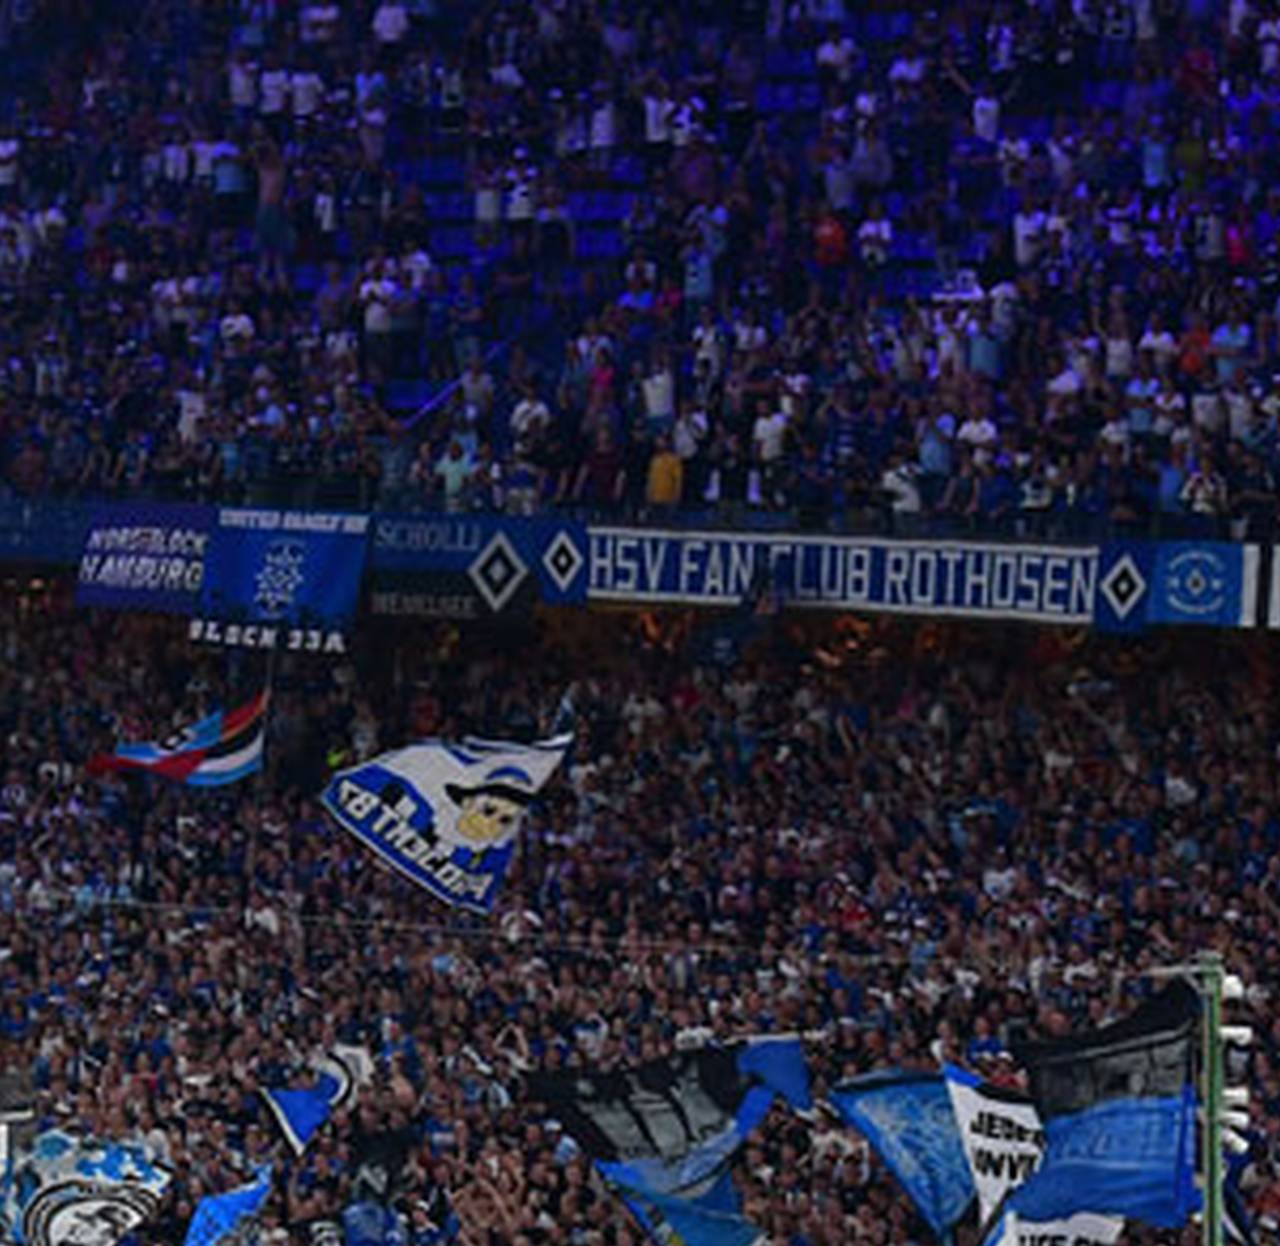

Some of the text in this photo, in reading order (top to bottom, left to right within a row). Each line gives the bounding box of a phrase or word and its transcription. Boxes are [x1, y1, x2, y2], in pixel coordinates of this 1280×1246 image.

[589, 534, 663, 594] HSV
[680, 538, 753, 598] FAN
[886, 550, 1095, 613] ROTHOSEN
[188, 618, 278, 649] BLOCK
